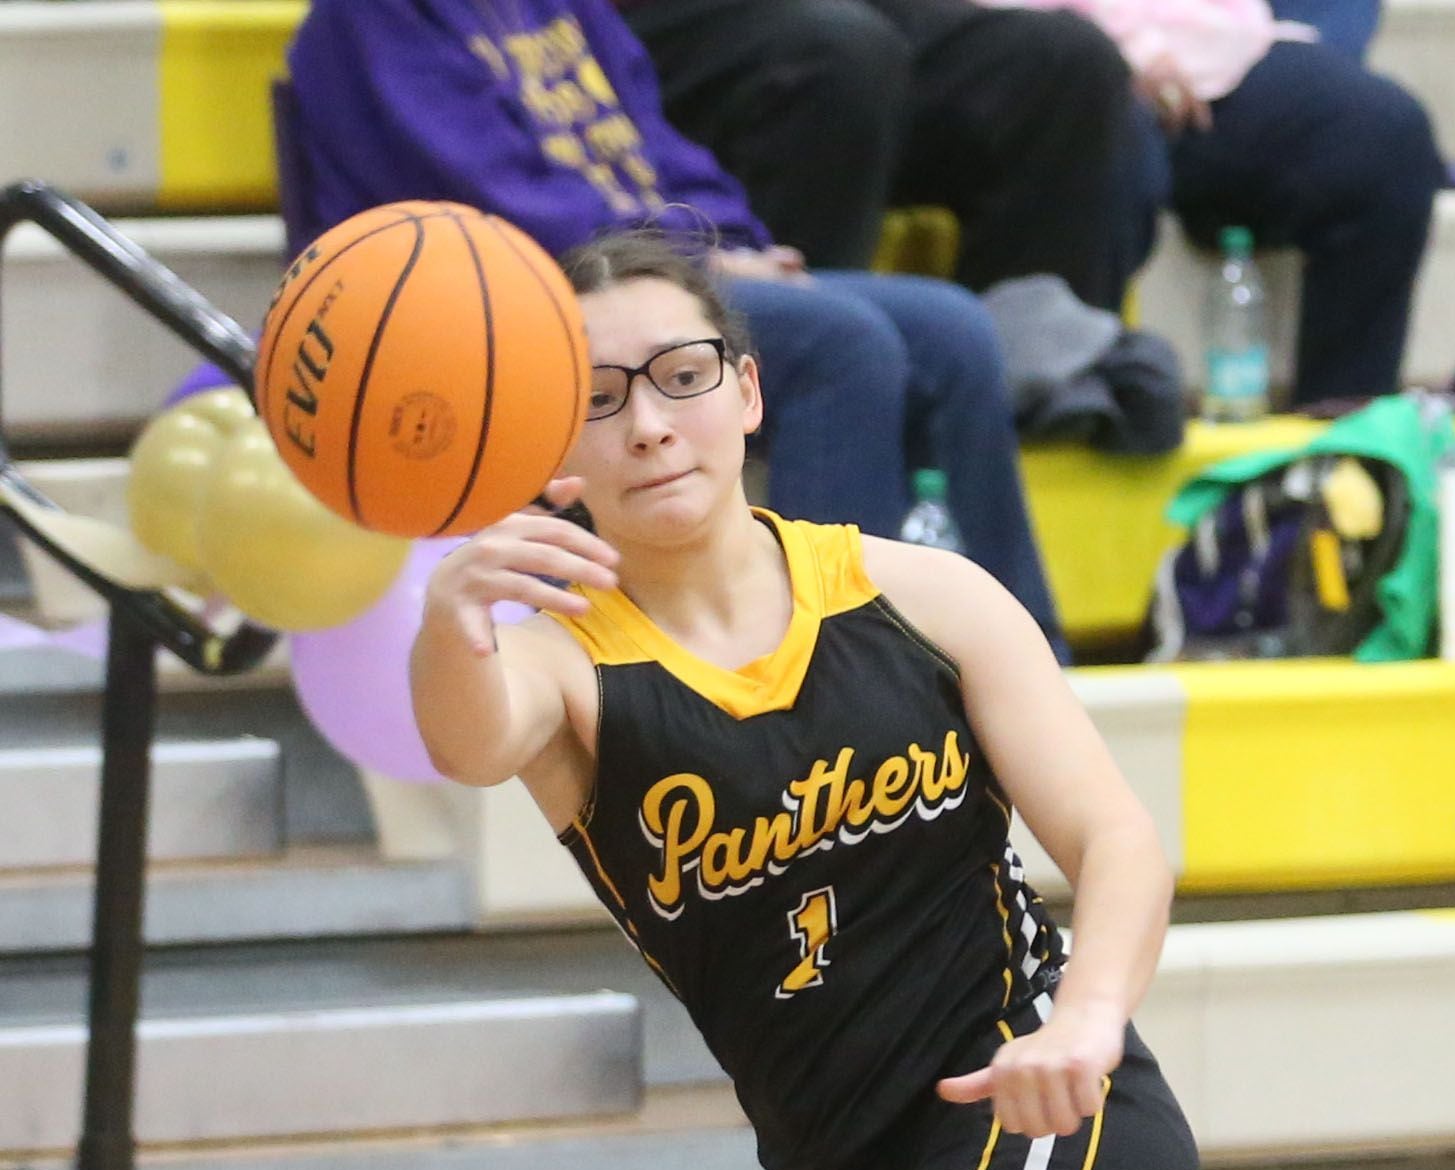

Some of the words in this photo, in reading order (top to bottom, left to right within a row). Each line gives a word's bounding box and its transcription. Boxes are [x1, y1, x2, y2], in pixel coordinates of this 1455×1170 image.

[283, 319, 335, 459] EVO
[638, 730, 970, 921] Panthers
[774, 885, 838, 999] 1
